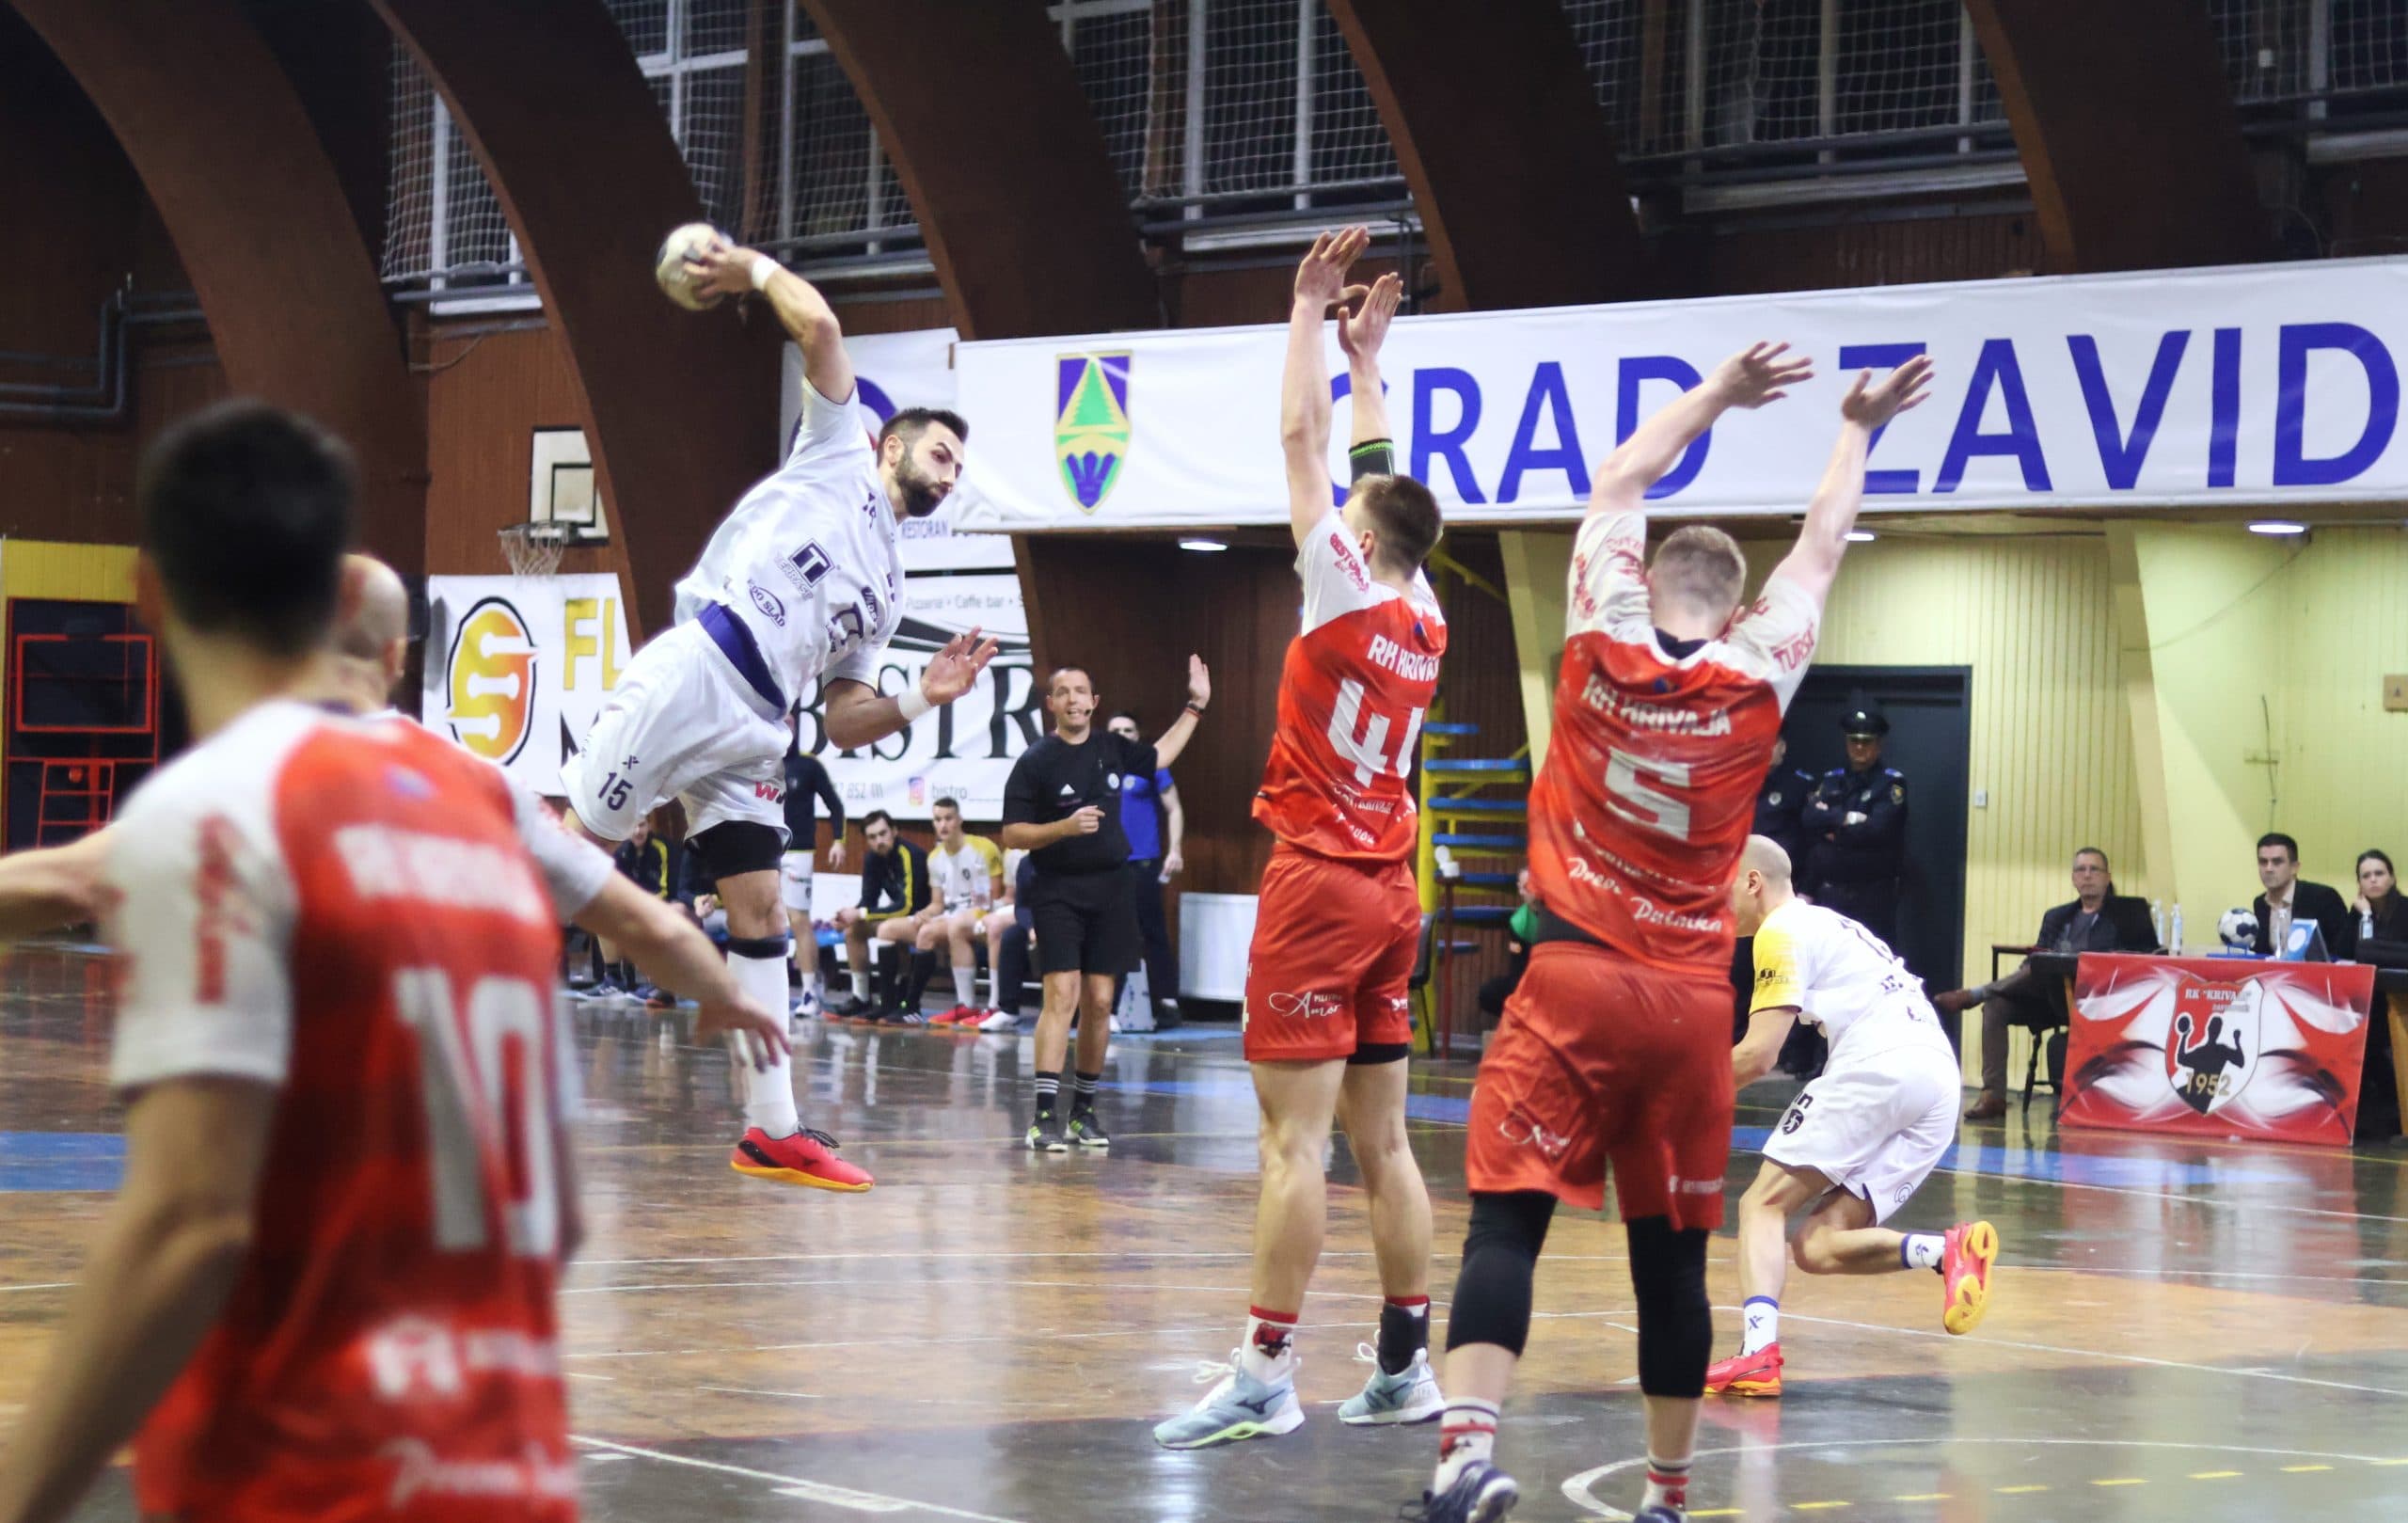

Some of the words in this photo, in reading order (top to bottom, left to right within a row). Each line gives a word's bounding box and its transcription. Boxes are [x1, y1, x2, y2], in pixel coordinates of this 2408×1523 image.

[1839, 322, 2400, 493] ZAVID
[763, 600, 785, 627] SLAD
[597, 771, 633, 811] 15
[1605, 746, 1690, 842] 5
[395, 967, 559, 1257] 10
[2186, 1072, 2231, 1096] 1952
